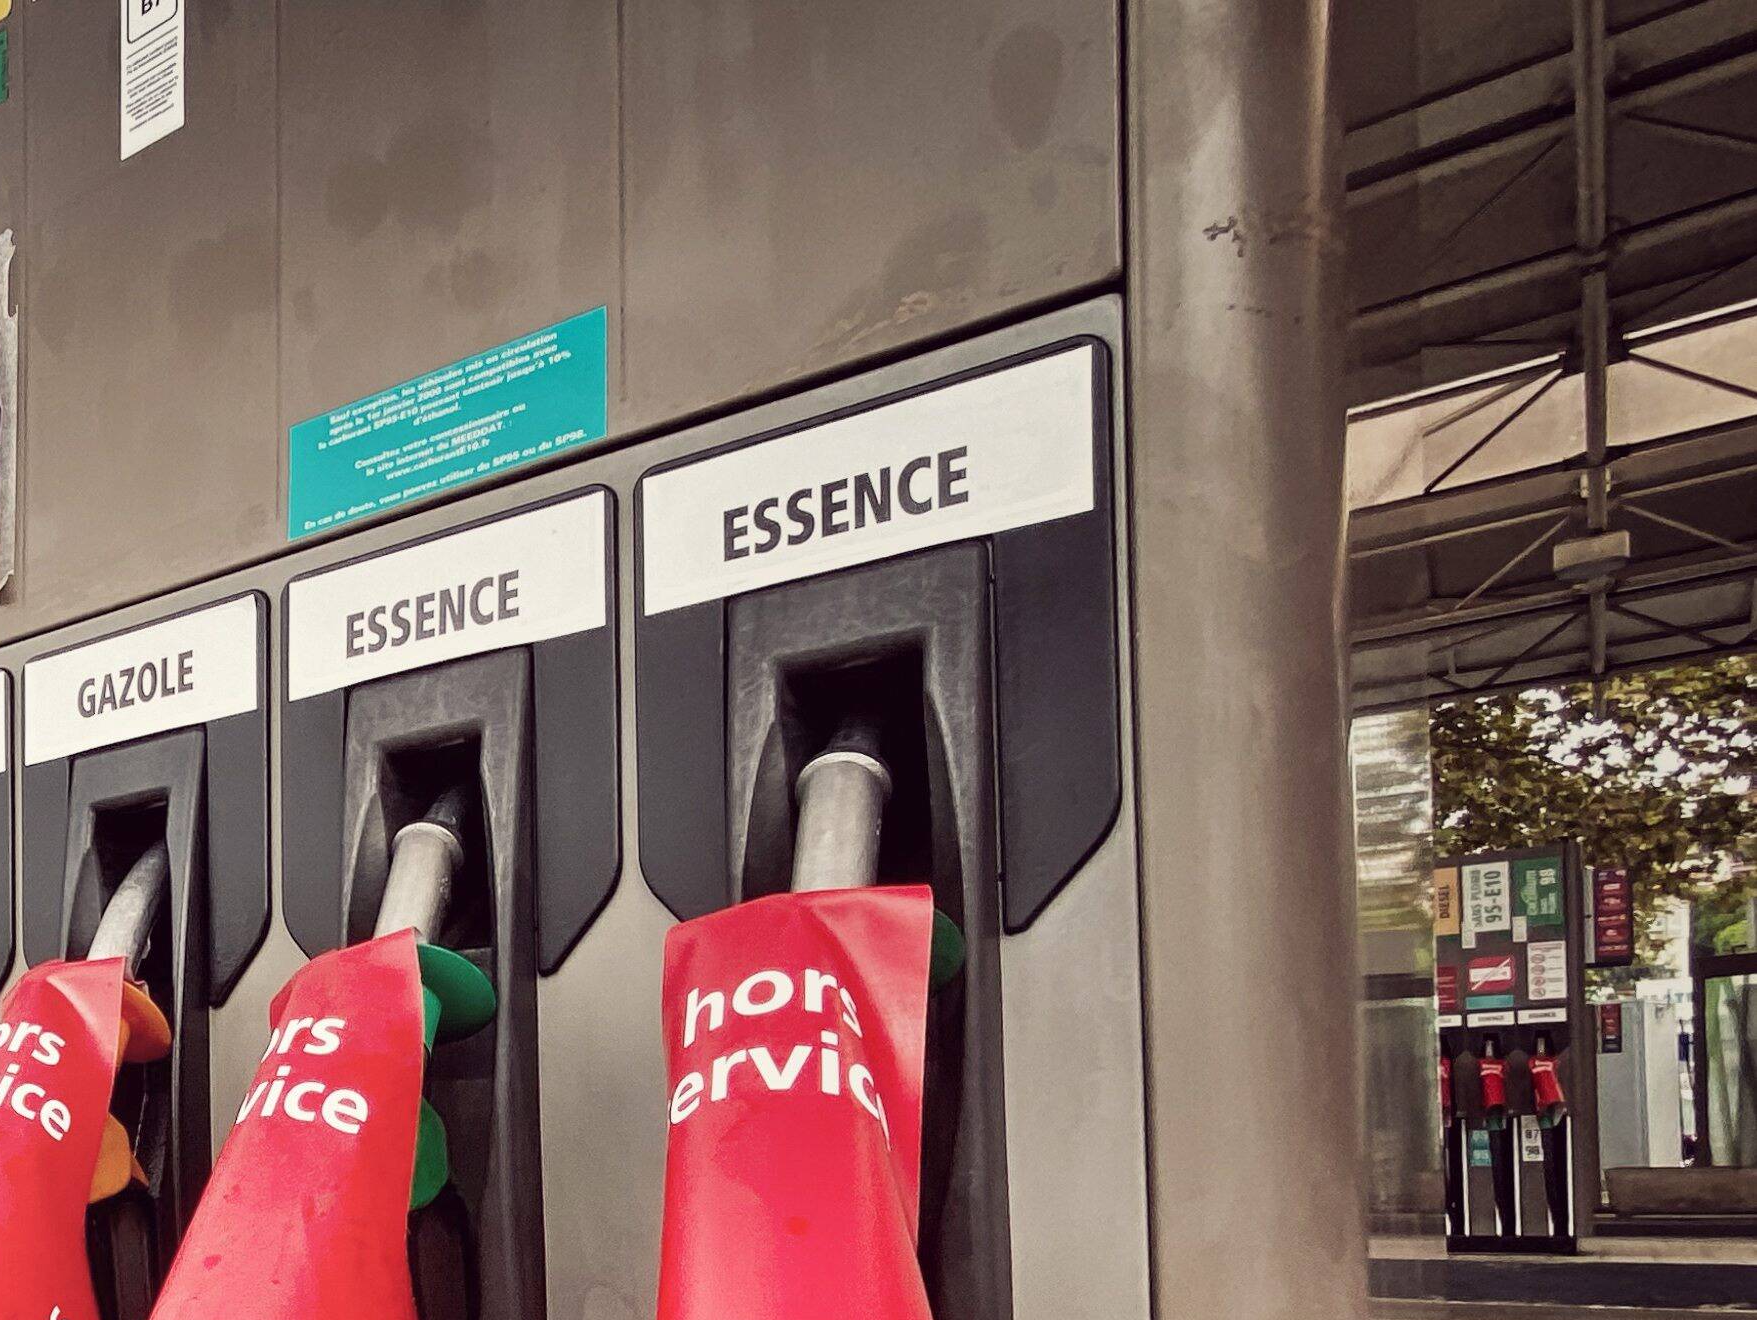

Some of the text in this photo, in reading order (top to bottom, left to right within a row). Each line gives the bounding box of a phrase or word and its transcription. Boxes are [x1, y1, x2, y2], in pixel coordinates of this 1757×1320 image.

[328, 425, 370, 445] carburant
[419, 391, 459, 413] pouvant
[462, 375, 503, 395] contenir
[548, 351, 570, 363] 10%
[330, 410, 349, 423] Sauf
[401, 387, 415, 396] les
[465, 360, 482, 372] mis
[485, 355, 498, 363] en
[501, 333, 556, 357] circulation
[355, 417, 363, 425] le
[383, 398, 414, 416] janvier
[418, 386, 441, 401] 2000
[444, 378, 465, 391] sont
[468, 355, 529, 382] compatibles
[533, 344, 557, 357] avec
[354, 403, 525, 468] Consultez votre concessionnaire ou
[376, 461, 393, 472] site
[396, 447, 433, 464] internet
[436, 442, 449, 450] du
[304, 520, 315, 529] En
[317, 516, 332, 525] cas
[334, 511, 345, 519] de
[347, 501, 375, 515] doute,
[379, 492, 400, 503] vous
[402, 480, 436, 497] pouvez
[439, 468, 473, 483] utiliser
[476, 462, 489, 471] du
[521, 447, 535, 456] ou
[538, 441, 552, 450] du
[723, 446, 969, 562] ESSENCE
[345, 569, 520, 660] ESSENCE
[77, 650, 194, 719] GAZOLE
[1438, 884, 1450, 919] DIESEL
[1483, 870, 1502, 924] 95-E10
[260, 1017, 346, 1064] rs
[670, 1030, 892, 1152] ervic
